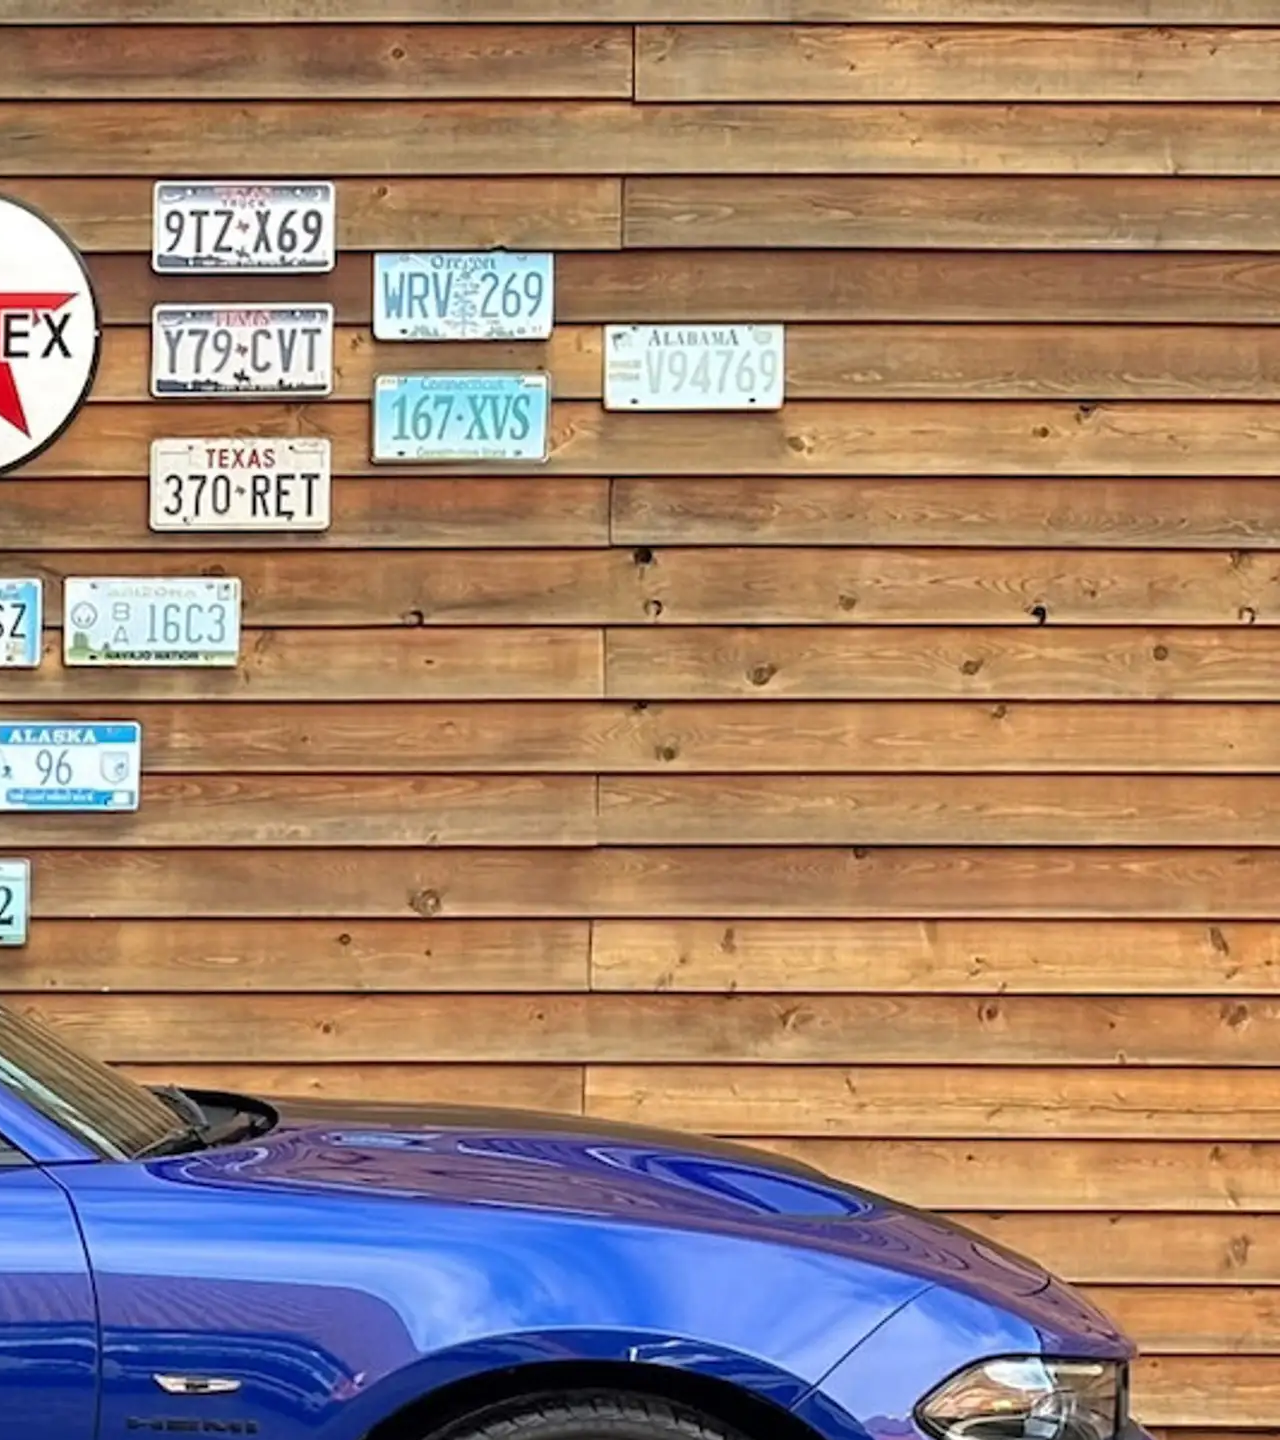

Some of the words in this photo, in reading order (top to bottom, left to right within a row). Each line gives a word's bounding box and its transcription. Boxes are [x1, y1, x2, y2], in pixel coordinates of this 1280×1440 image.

[165, 210, 234, 253] 9TZ
[253, 210, 323, 253] X69
[383, 271, 454, 319] WRV
[480, 271, 543, 318] 269
[164, 328, 233, 374] Y79
[251, 328, 322, 373] CVT
[648, 329, 740, 346] ALABAMA
[645, 349, 778, 394] V94769
[205, 449, 276, 469] TEXAS
[164, 474, 231, 516] 370
[251, 474, 320, 516] RET
[147, 603, 226, 643] 16C3
[8, 728, 97, 744] ALASKA
[35, 749, 73, 786] 96
